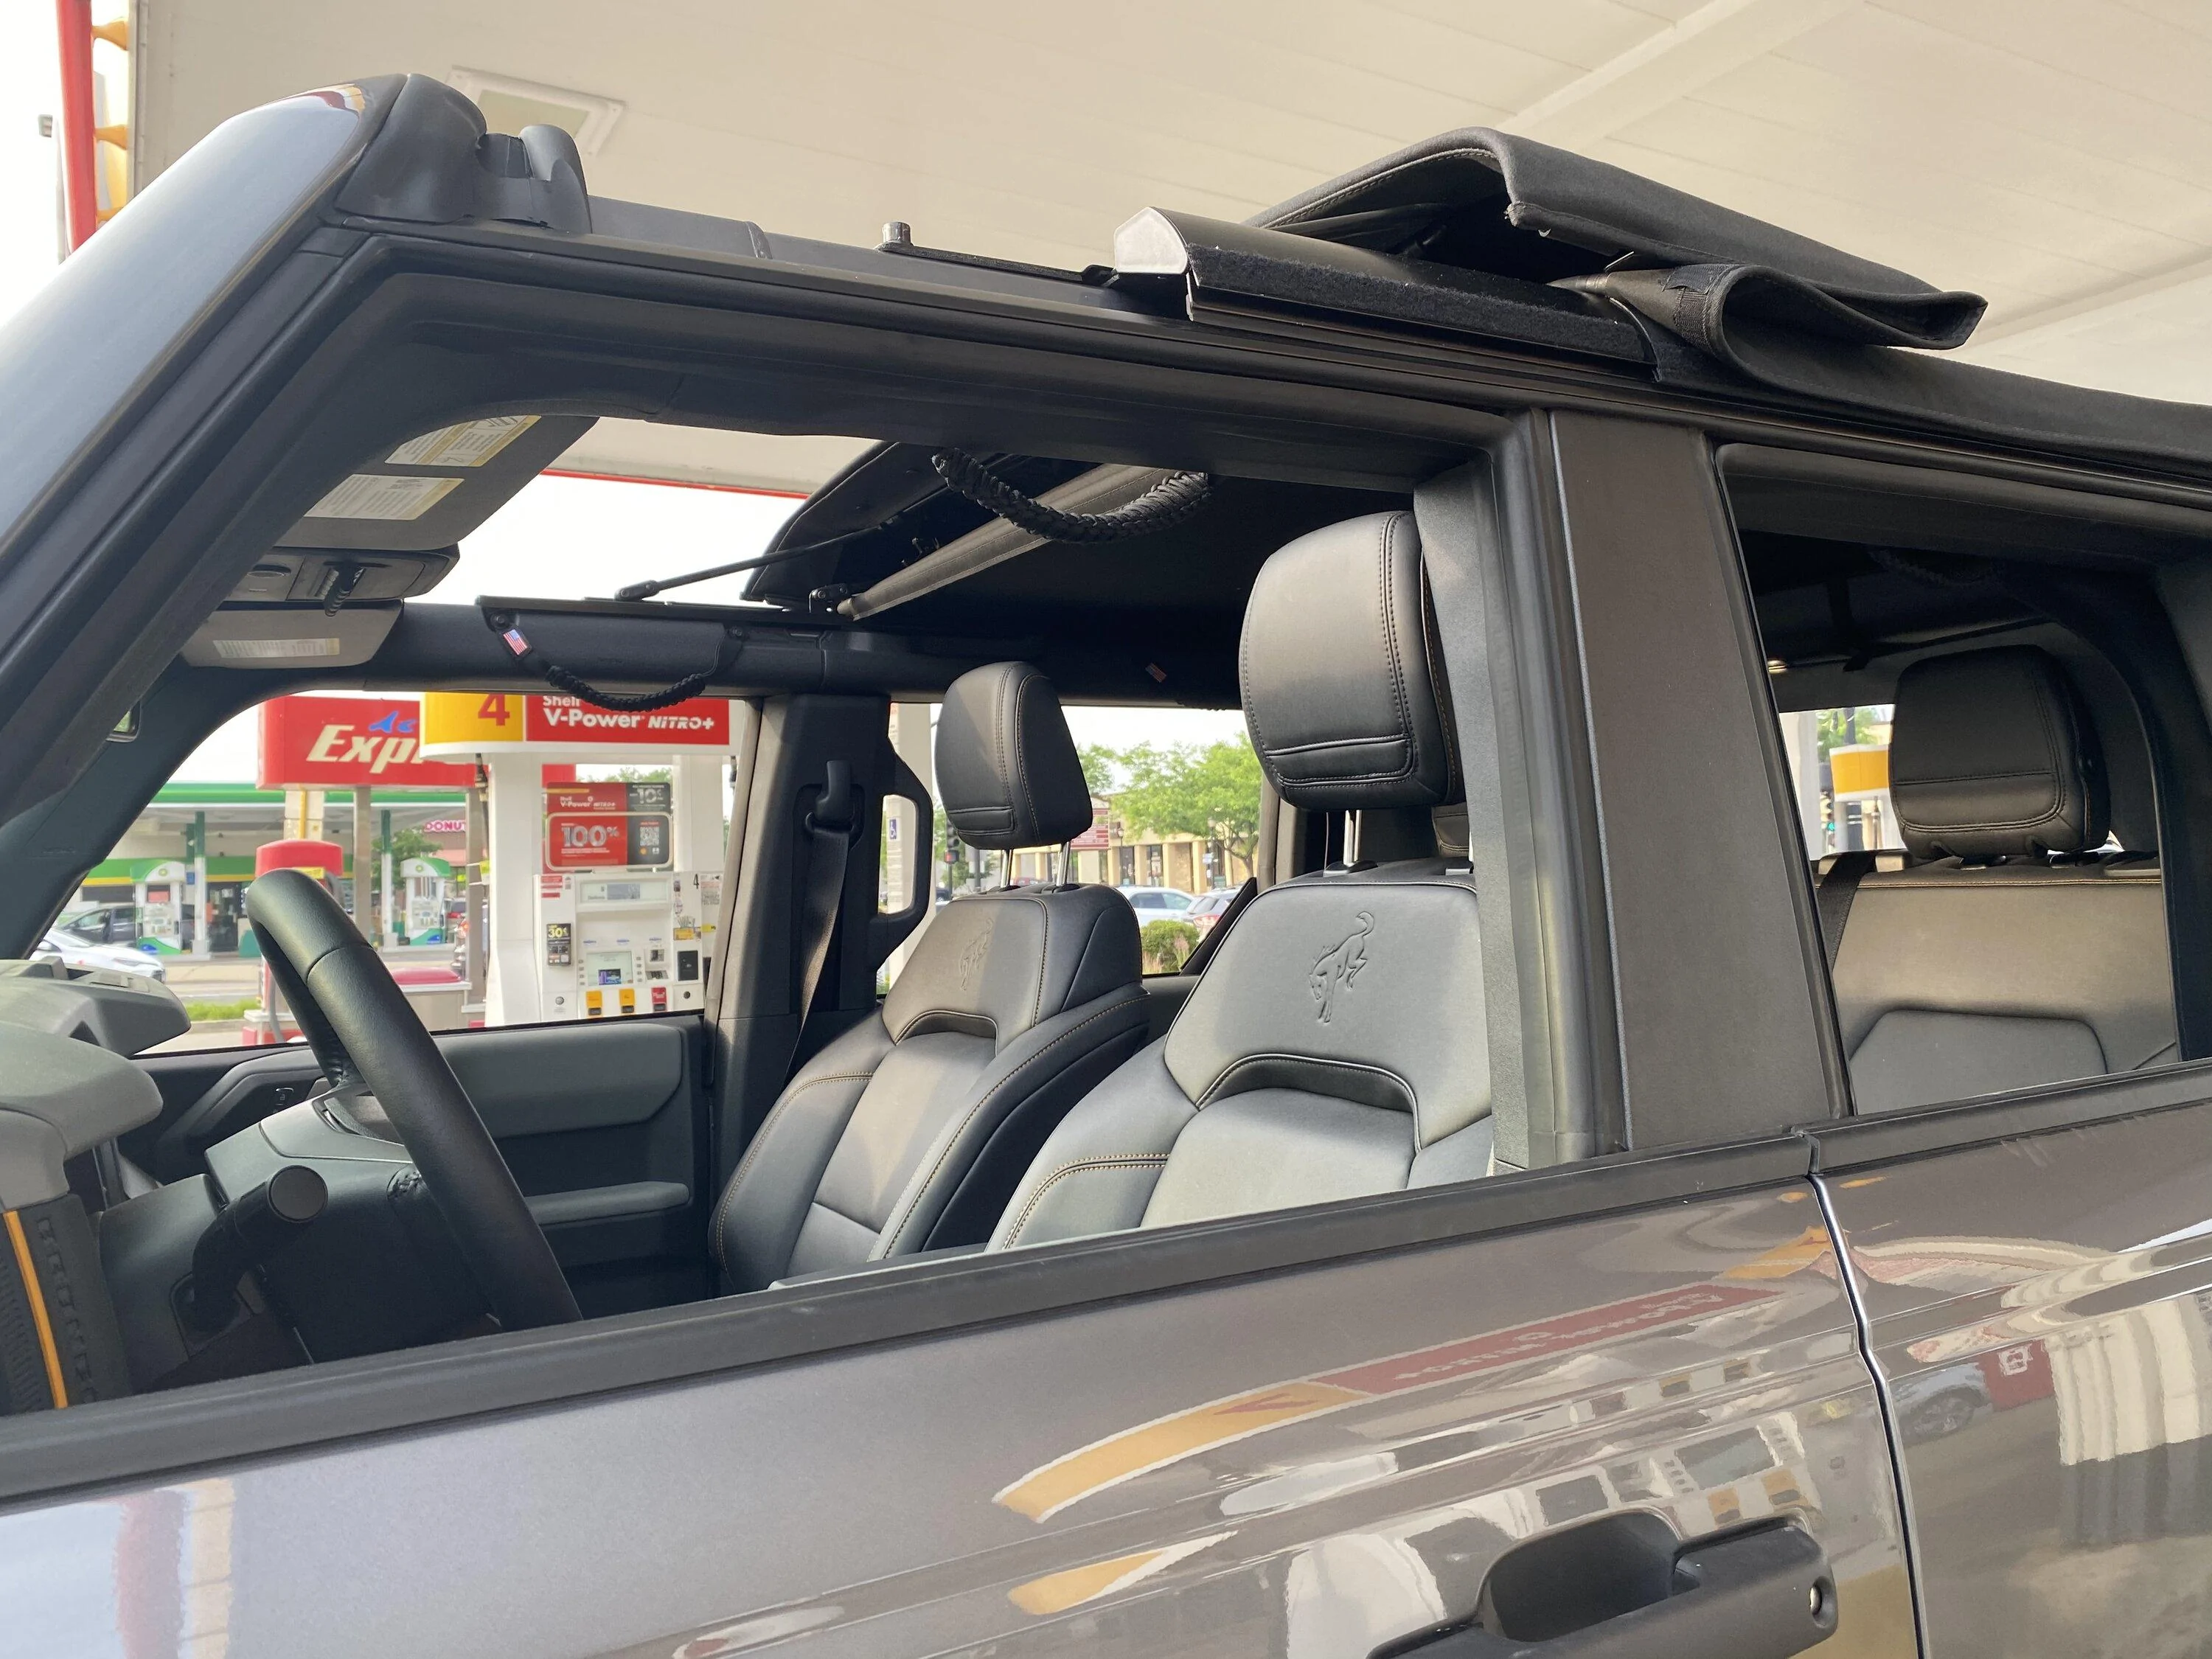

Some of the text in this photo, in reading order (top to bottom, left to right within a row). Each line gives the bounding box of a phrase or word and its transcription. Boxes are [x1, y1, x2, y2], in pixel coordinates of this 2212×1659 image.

[478, 694, 510, 726] 4
[543, 695, 580, 706] Shell
[543, 708, 641, 727] V-Power
[561, 825, 620, 847] 100%
[693, 873, 700, 889] 4
